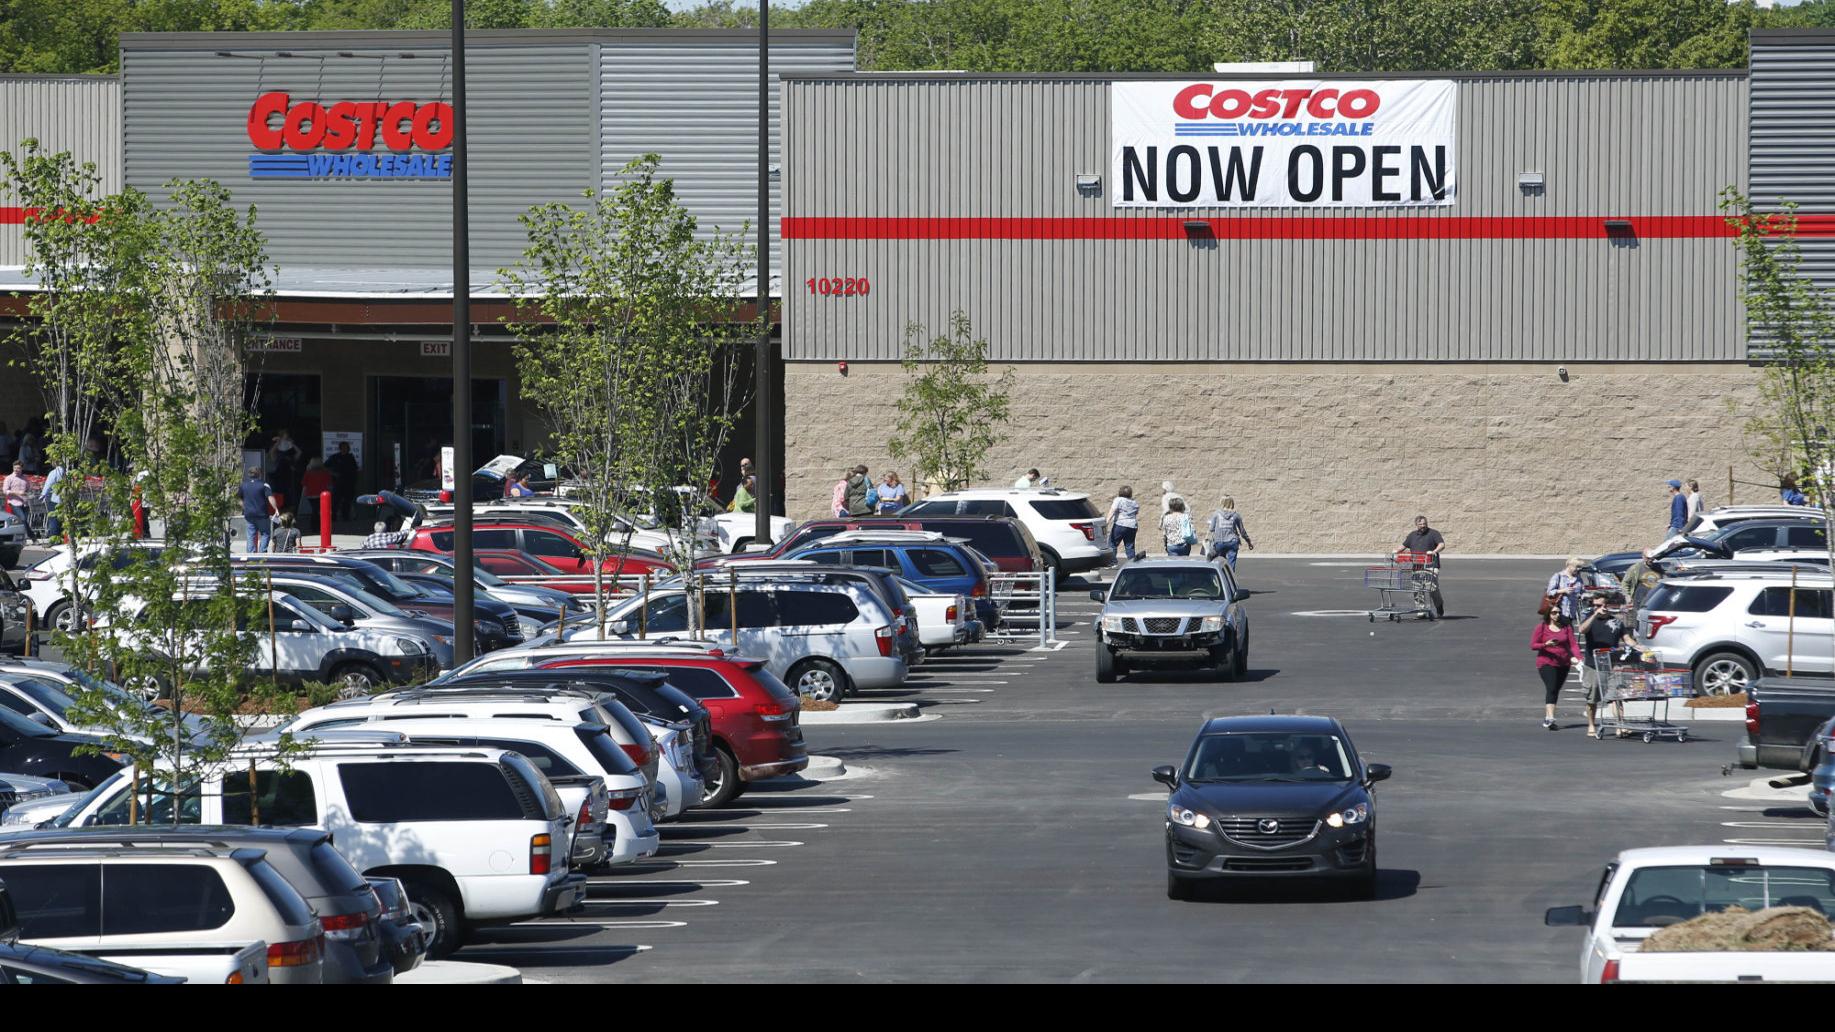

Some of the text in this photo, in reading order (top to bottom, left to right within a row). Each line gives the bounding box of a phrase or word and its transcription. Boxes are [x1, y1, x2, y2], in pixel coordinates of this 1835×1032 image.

[1172, 83, 1381, 120] COSTCO
[247, 91, 454, 151] COSTCO
[1237, 122, 1375, 137] WHOLESALE
[307, 154, 454, 177] WHOLESALE
[1122, 144, 1447, 203] NOW OPEN
[806, 277, 871, 296] 10220
[423, 343, 448, 353] EXIT
